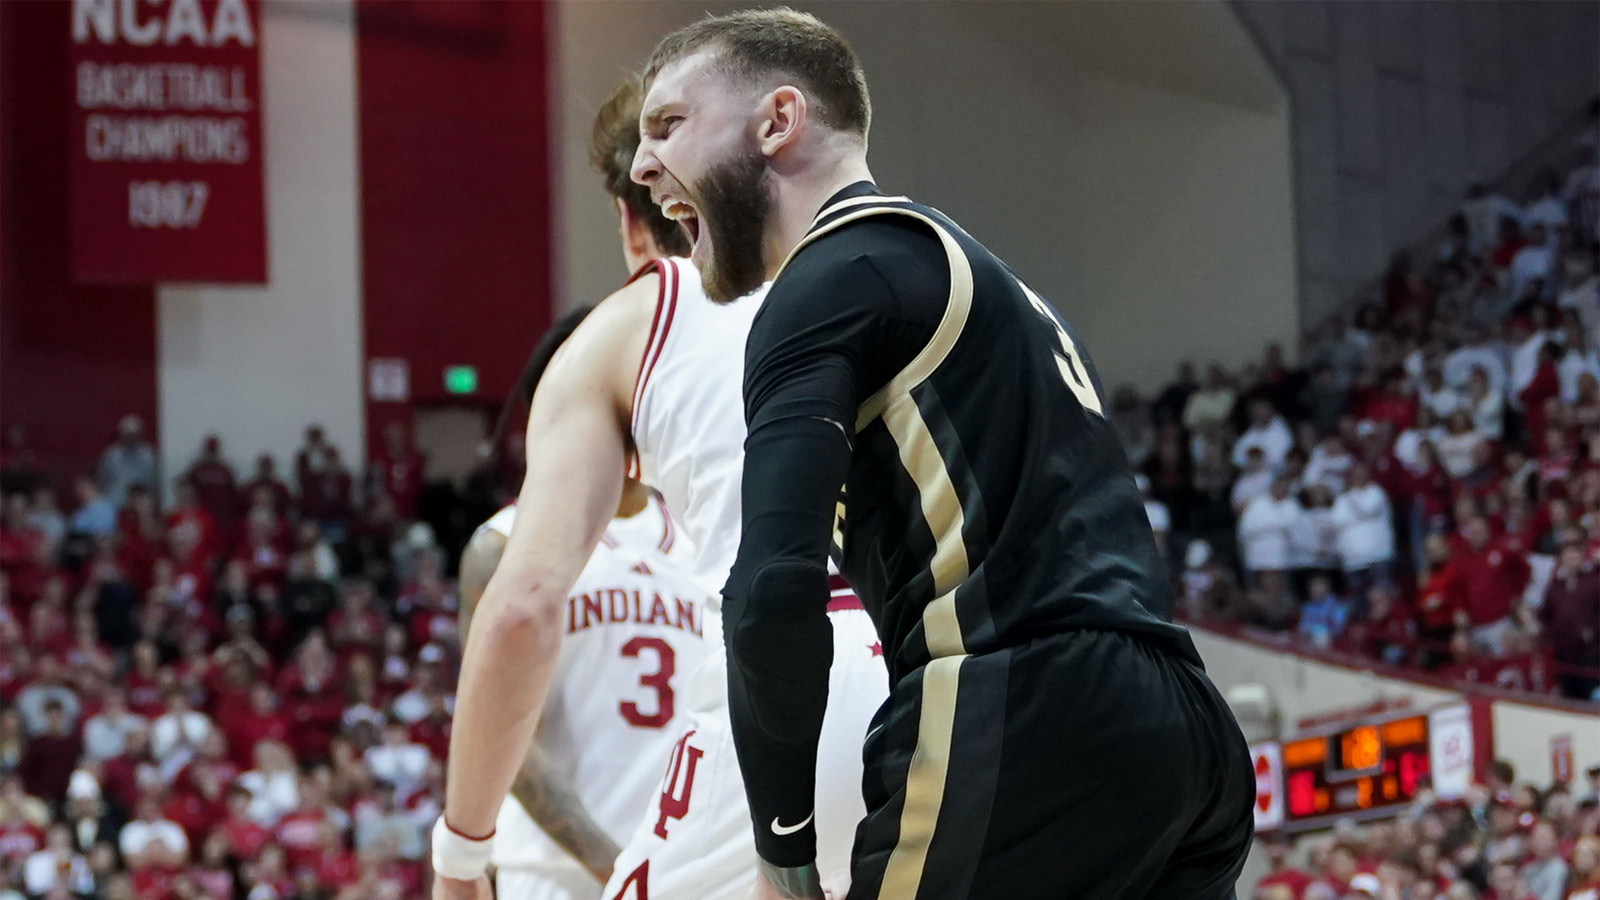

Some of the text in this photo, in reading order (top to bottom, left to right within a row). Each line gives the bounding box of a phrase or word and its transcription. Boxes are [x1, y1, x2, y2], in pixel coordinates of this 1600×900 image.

[72, 0, 253, 46] NCAA
[77, 62, 248, 111] BASKETBALL
[86, 115, 248, 163] CHAMPIONS
[567, 589, 704, 638] INDIAN
[619, 637, 675, 728] 3
